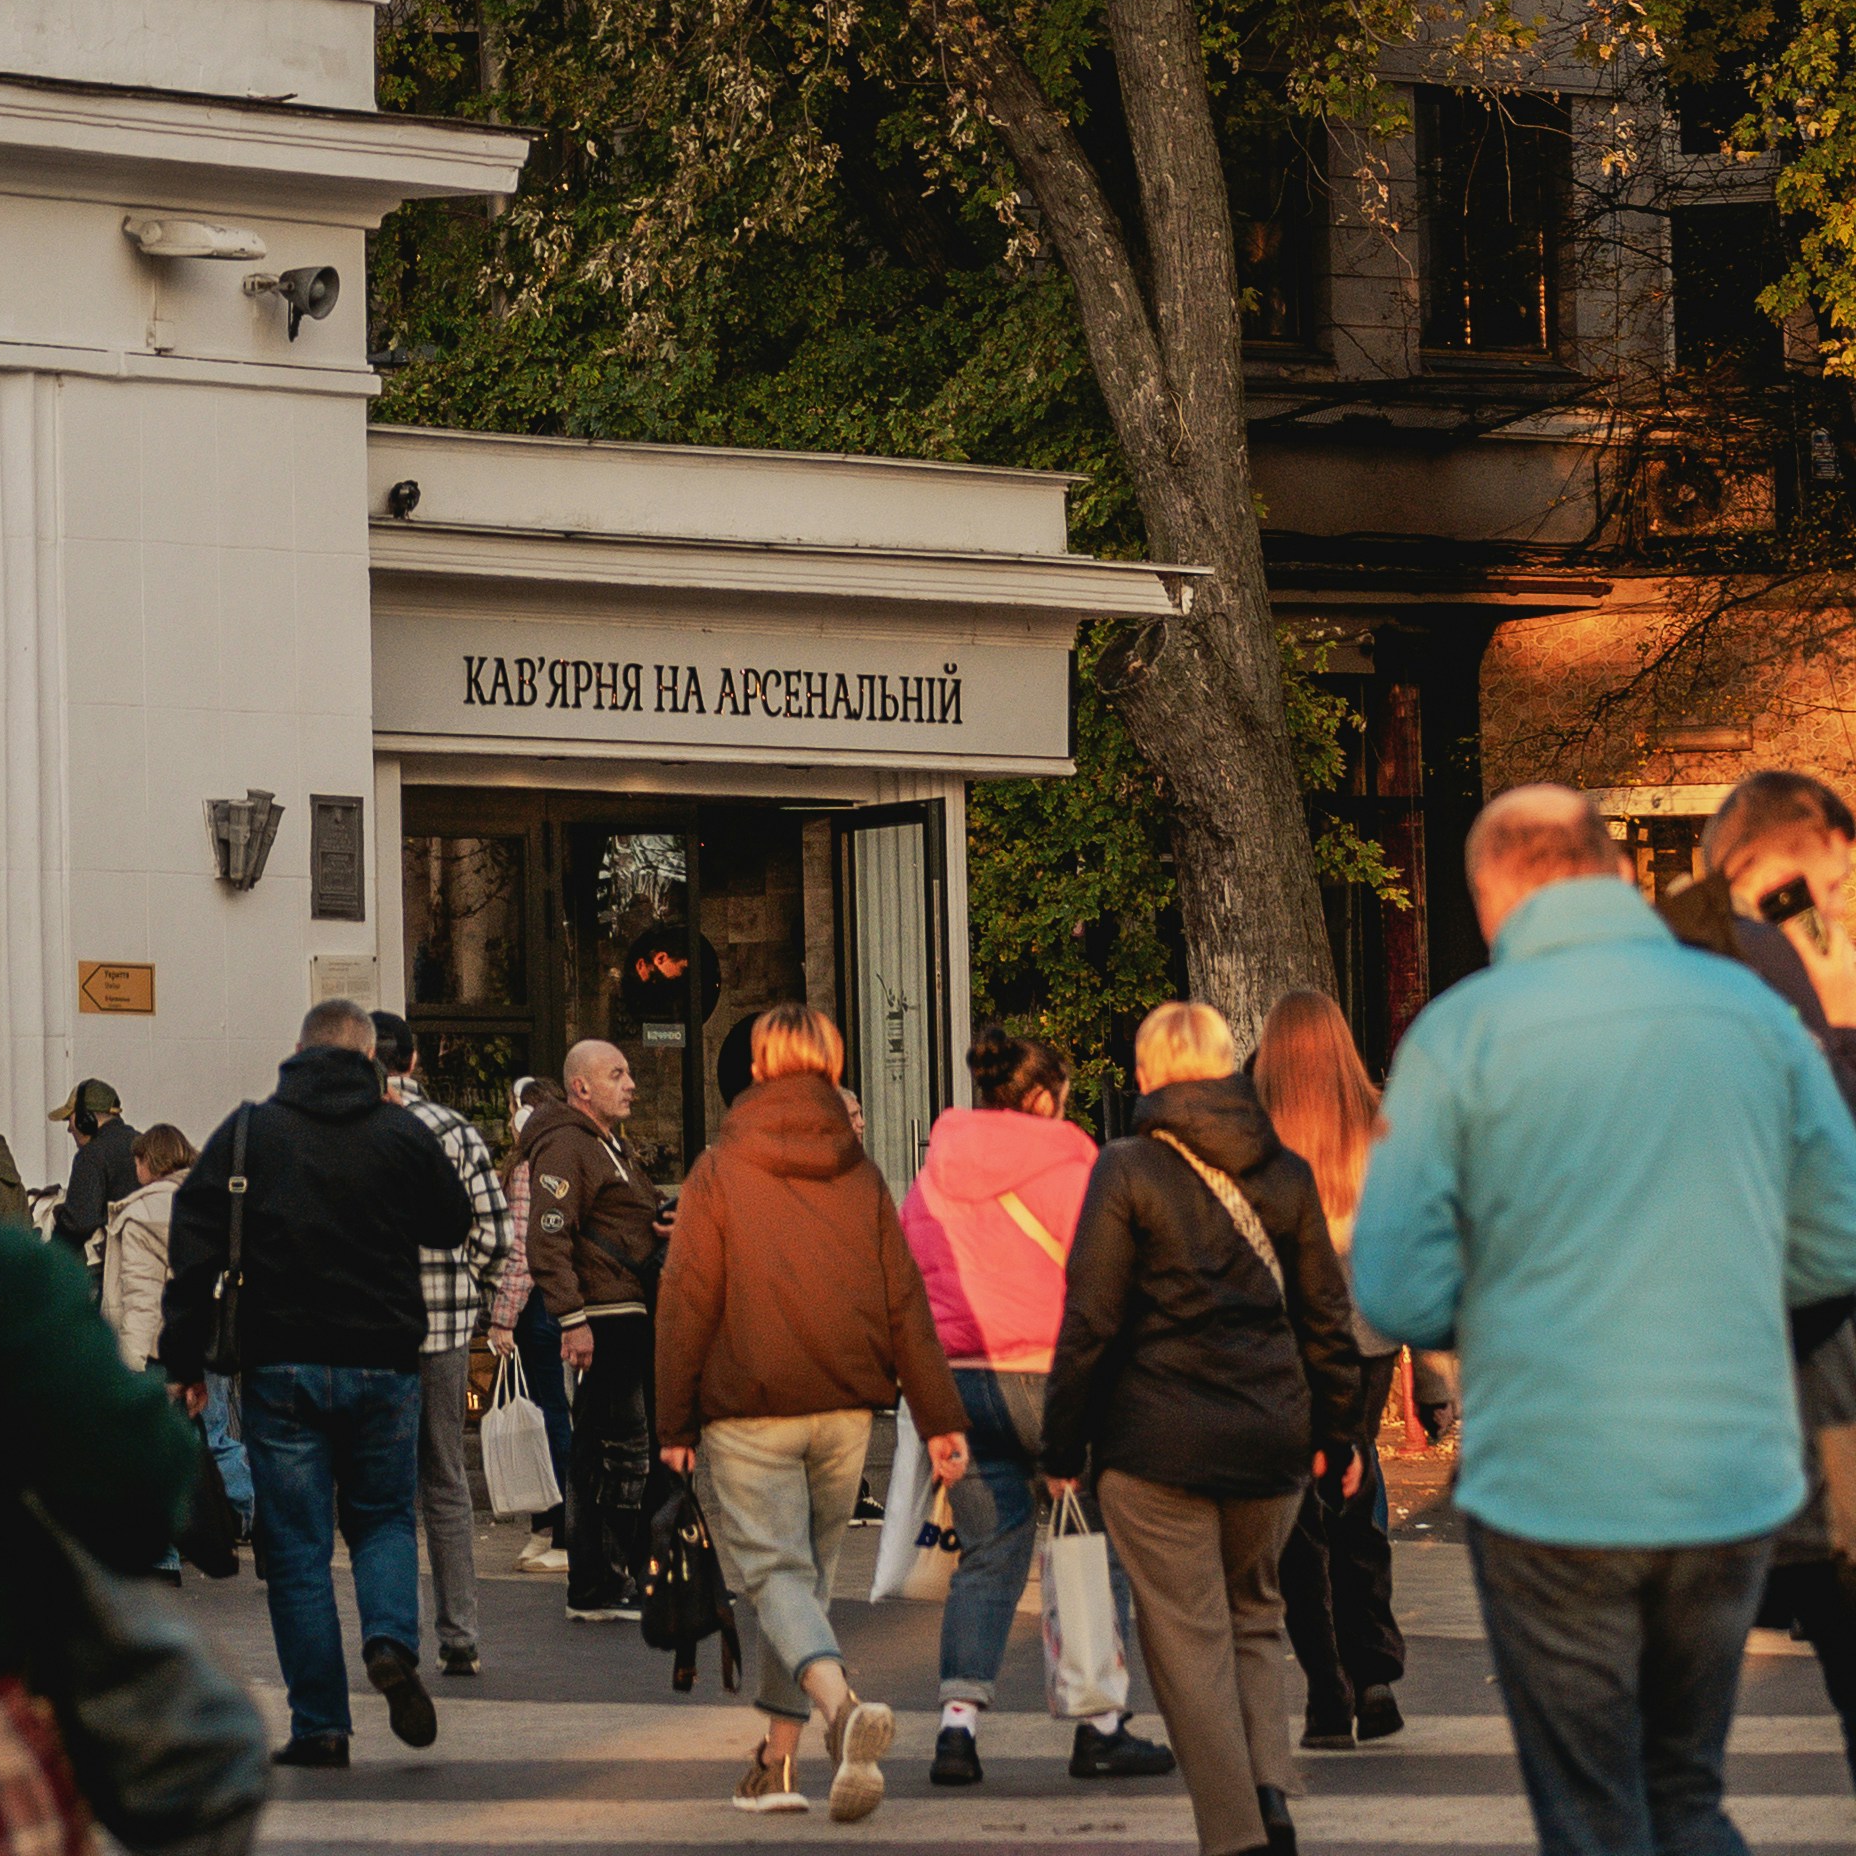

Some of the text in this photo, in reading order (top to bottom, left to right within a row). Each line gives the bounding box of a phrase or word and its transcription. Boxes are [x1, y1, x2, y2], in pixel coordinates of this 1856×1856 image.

[653, 664, 707, 714] НА
[713, 663, 963, 724] АРСЕНАЛЬНІЙ
[915, 1521, 962, 1552] BO
